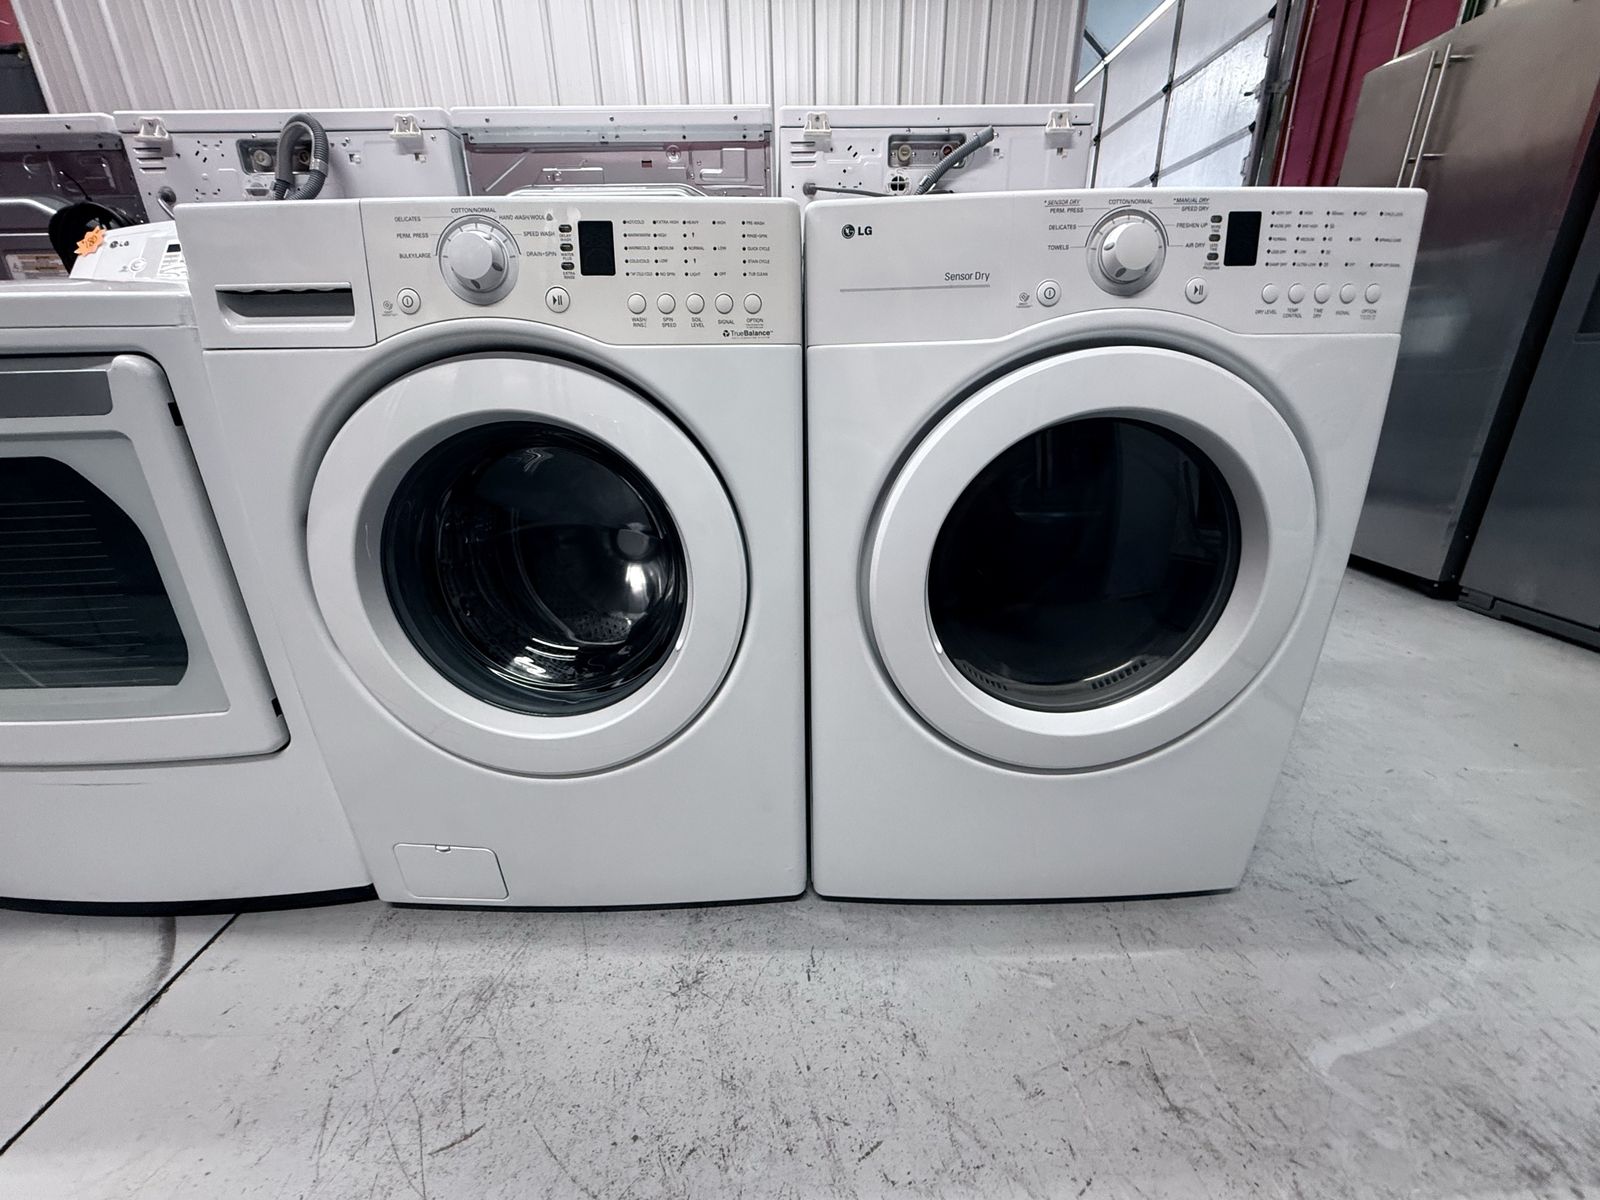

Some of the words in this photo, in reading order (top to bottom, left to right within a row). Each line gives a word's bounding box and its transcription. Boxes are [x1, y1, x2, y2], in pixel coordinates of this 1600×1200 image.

[857, 226, 872, 236] LG
[944, 272, 973, 281] Sensor
[975, 272, 990, 282] Dry
